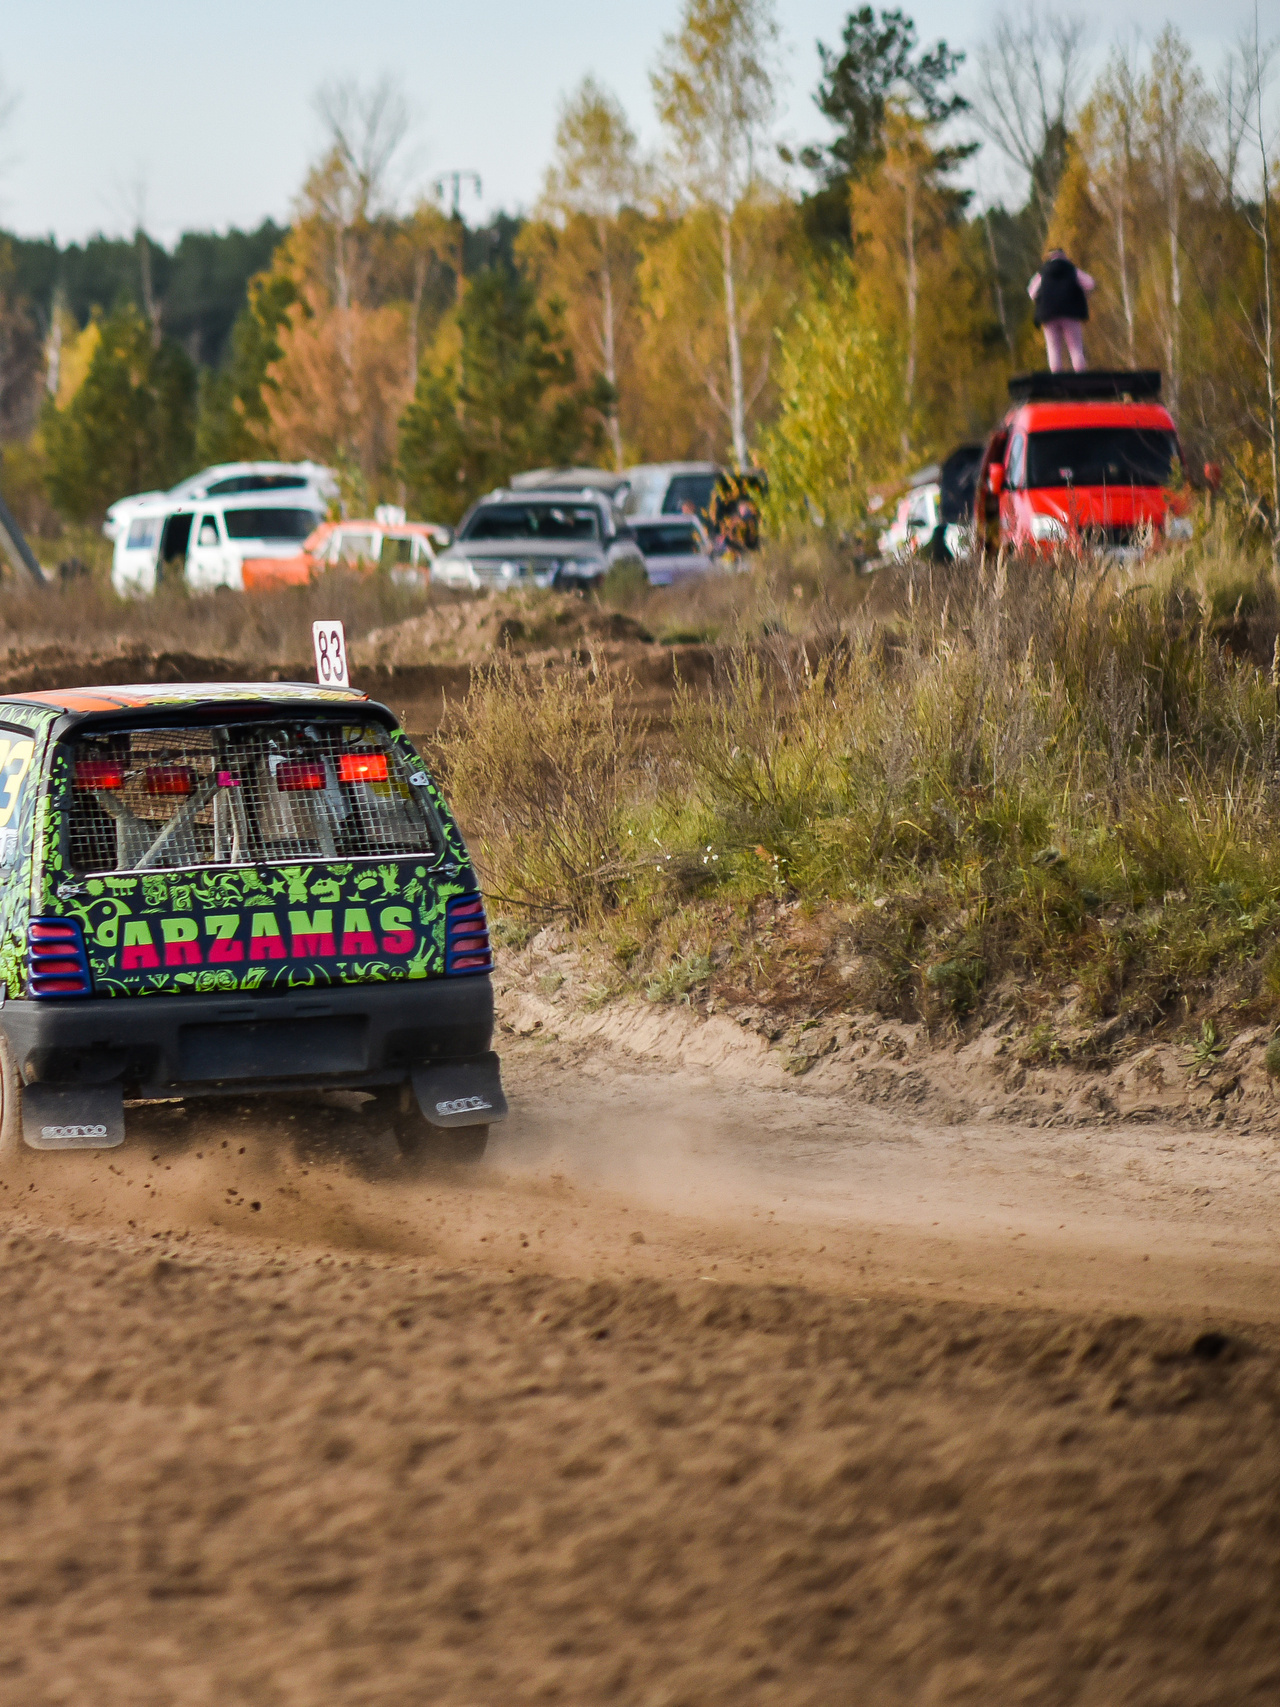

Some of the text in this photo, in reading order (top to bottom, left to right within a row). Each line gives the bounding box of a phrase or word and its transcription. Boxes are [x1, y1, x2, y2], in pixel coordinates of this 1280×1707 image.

[318, 630, 344, 682] 83
[120, 905, 416, 970] ARZAMAS
[435, 1096, 492, 1116] sparc
